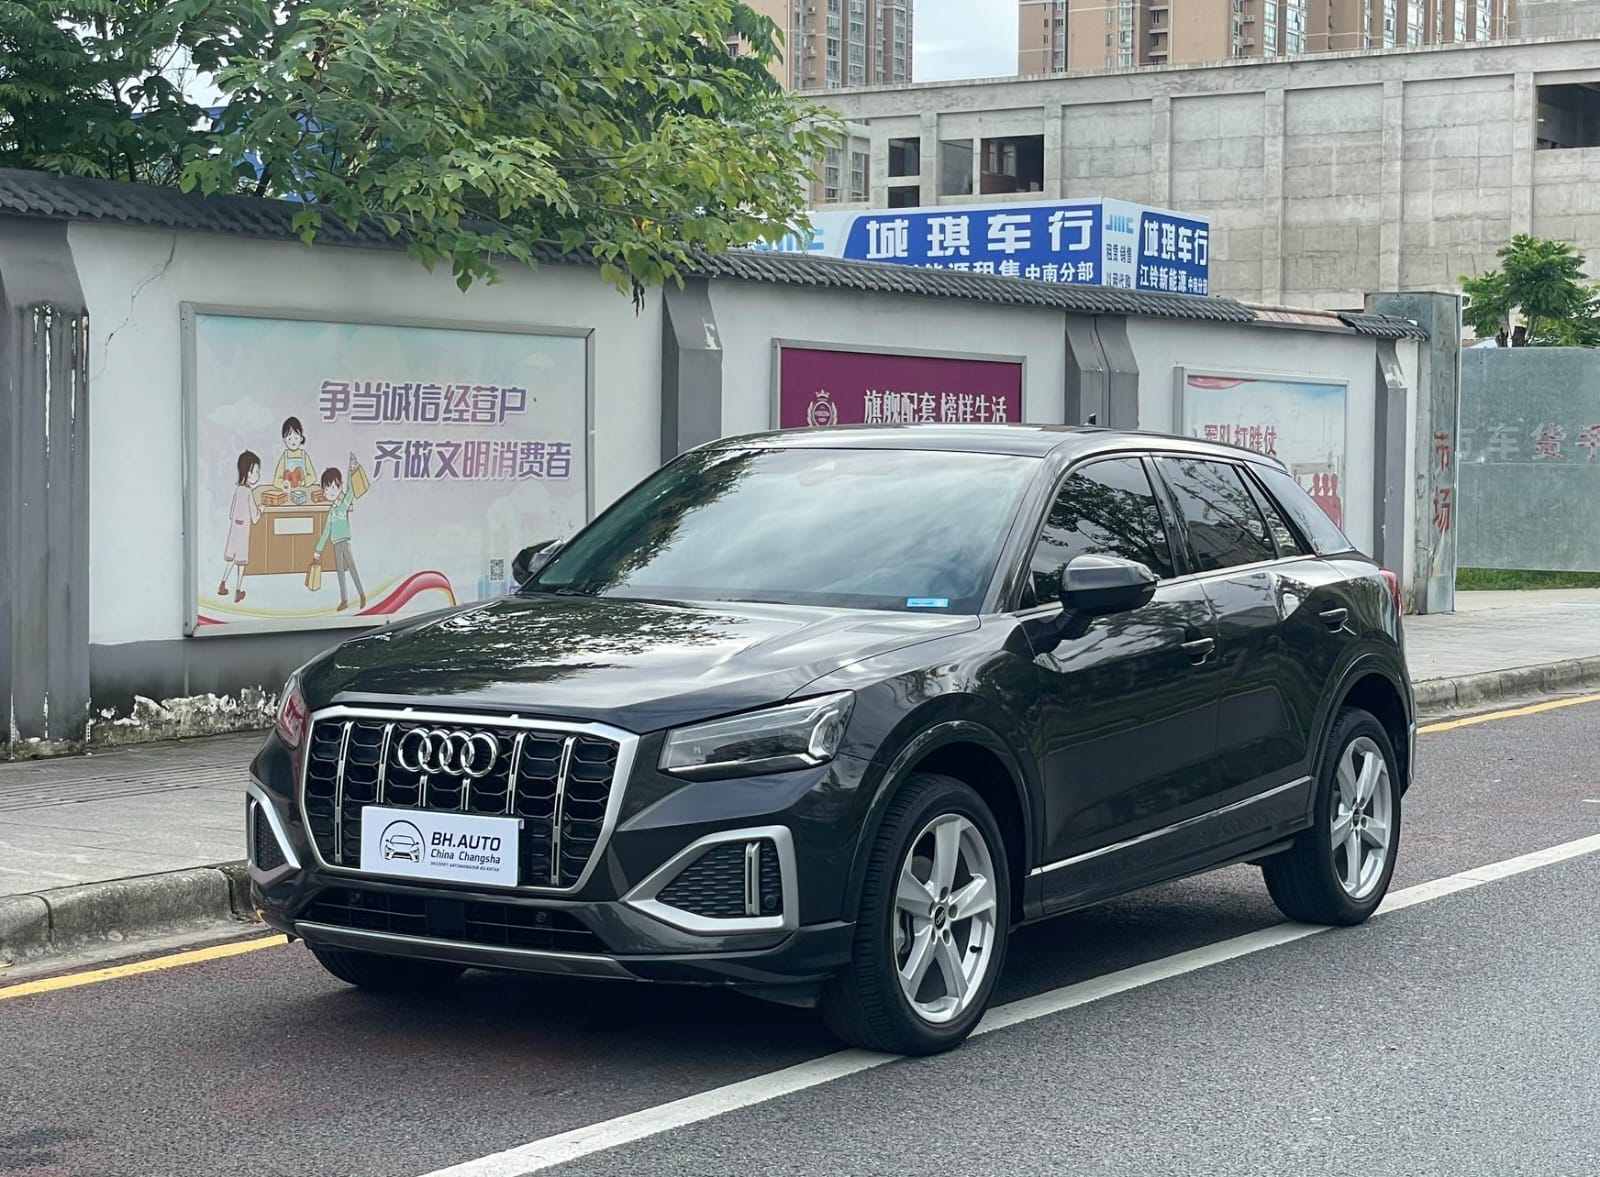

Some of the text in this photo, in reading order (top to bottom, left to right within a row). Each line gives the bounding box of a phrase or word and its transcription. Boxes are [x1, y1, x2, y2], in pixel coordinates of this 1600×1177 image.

[866, 210, 1093, 258] 城琪车行
[1143, 219, 1208, 266] 城琪车行
[1140, 264, 1187, 292] 江铃新能源
[319, 380, 527, 424] 争当诚信经营户
[864, 389, 936, 423] 旗舰配套
[940, 392, 1007, 423] 榜样生活
[373, 439, 572, 480] 齐做文明消费者
[431, 831, 501, 852] BH.AUTO
[431, 849, 501, 865] China Changsha
